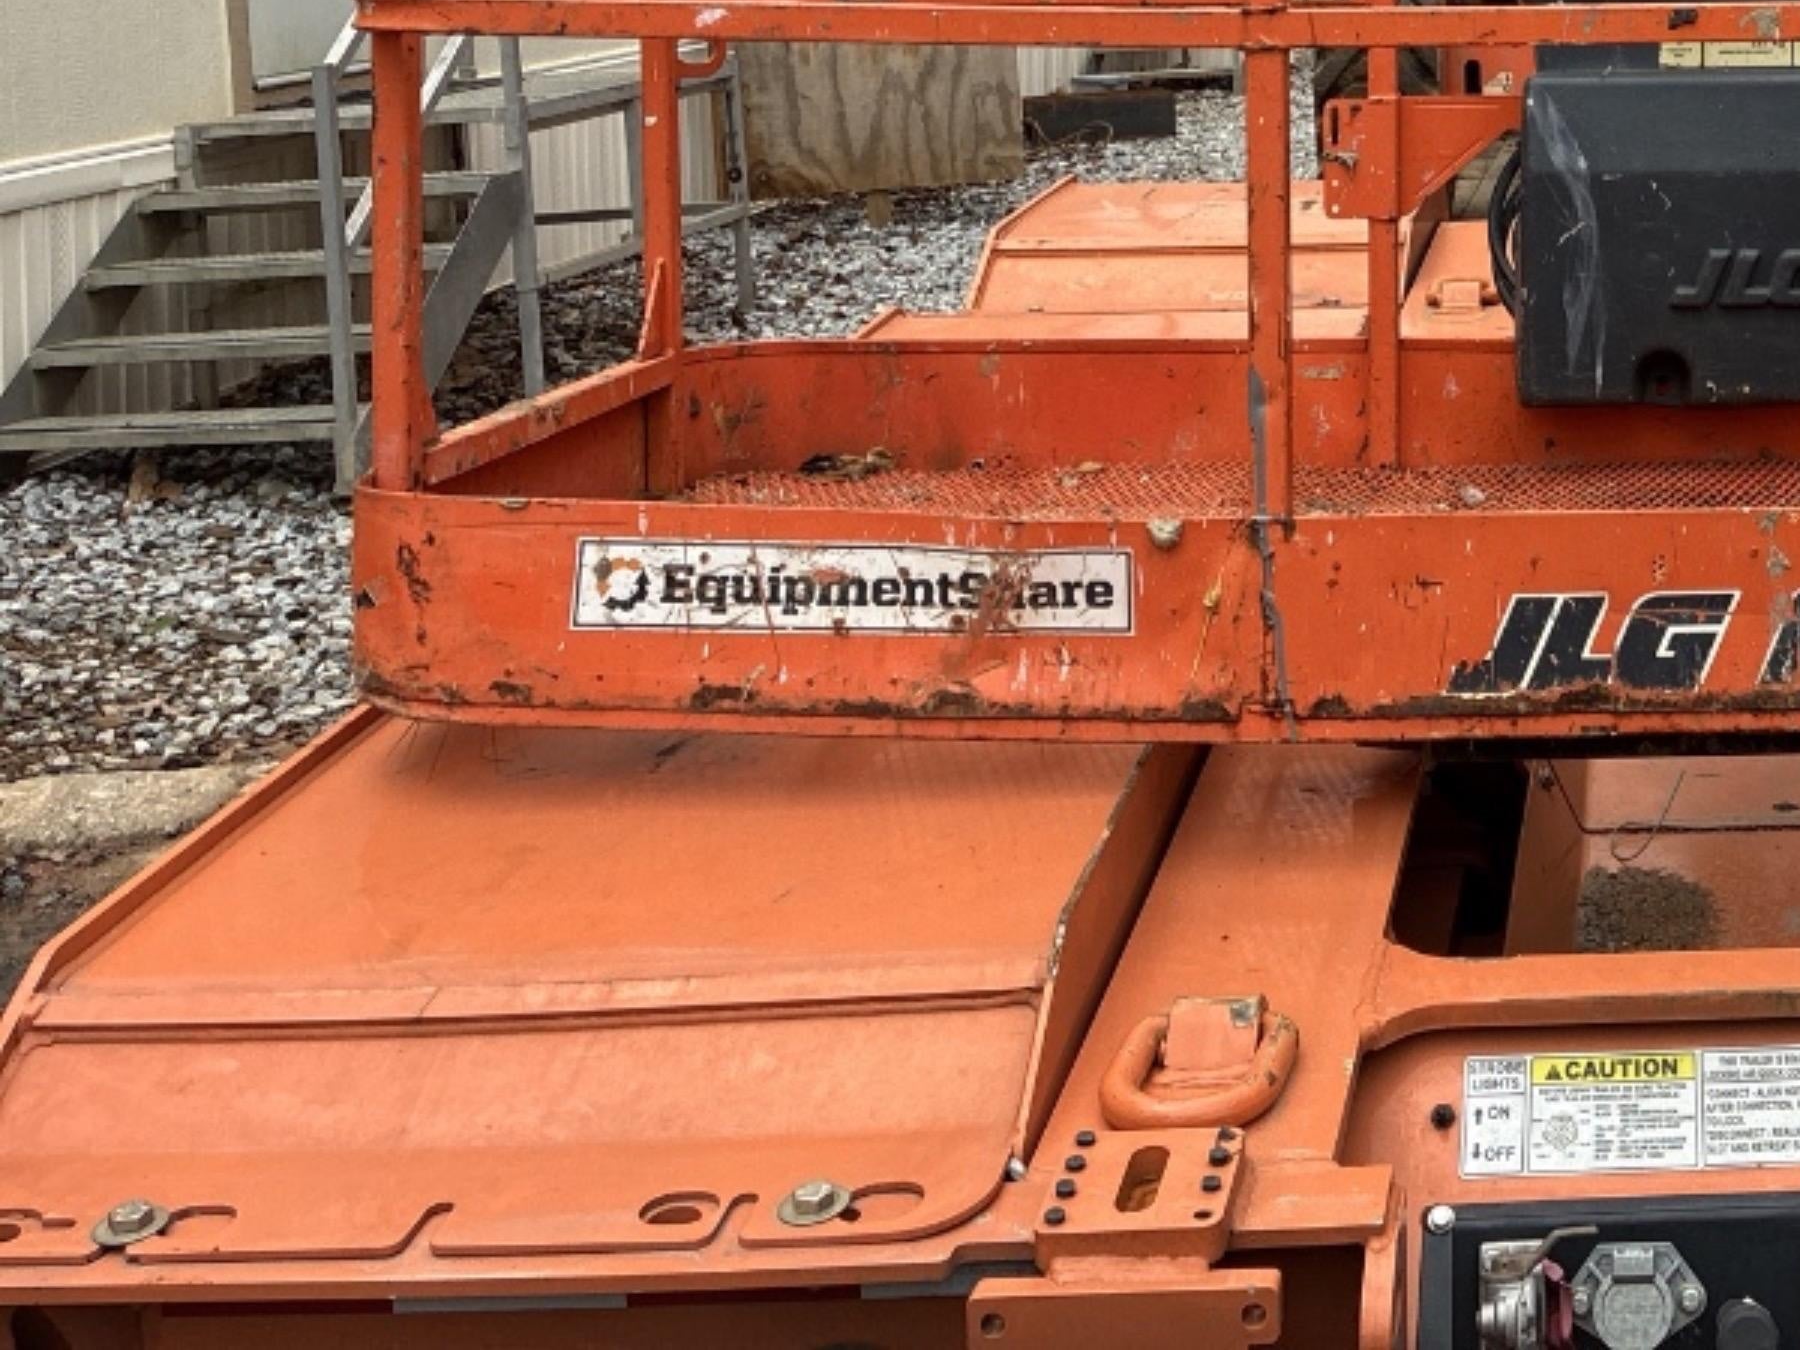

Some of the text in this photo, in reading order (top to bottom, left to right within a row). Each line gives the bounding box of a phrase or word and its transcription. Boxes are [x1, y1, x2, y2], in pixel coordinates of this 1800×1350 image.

[1441, 590, 1742, 698] JLG
[1564, 1058, 1678, 1081] CAUTION
[1472, 1077, 1520, 1090] LIGHTS
[1487, 1105, 1511, 1120] ON
[1484, 1145, 1516, 1162] OFF
